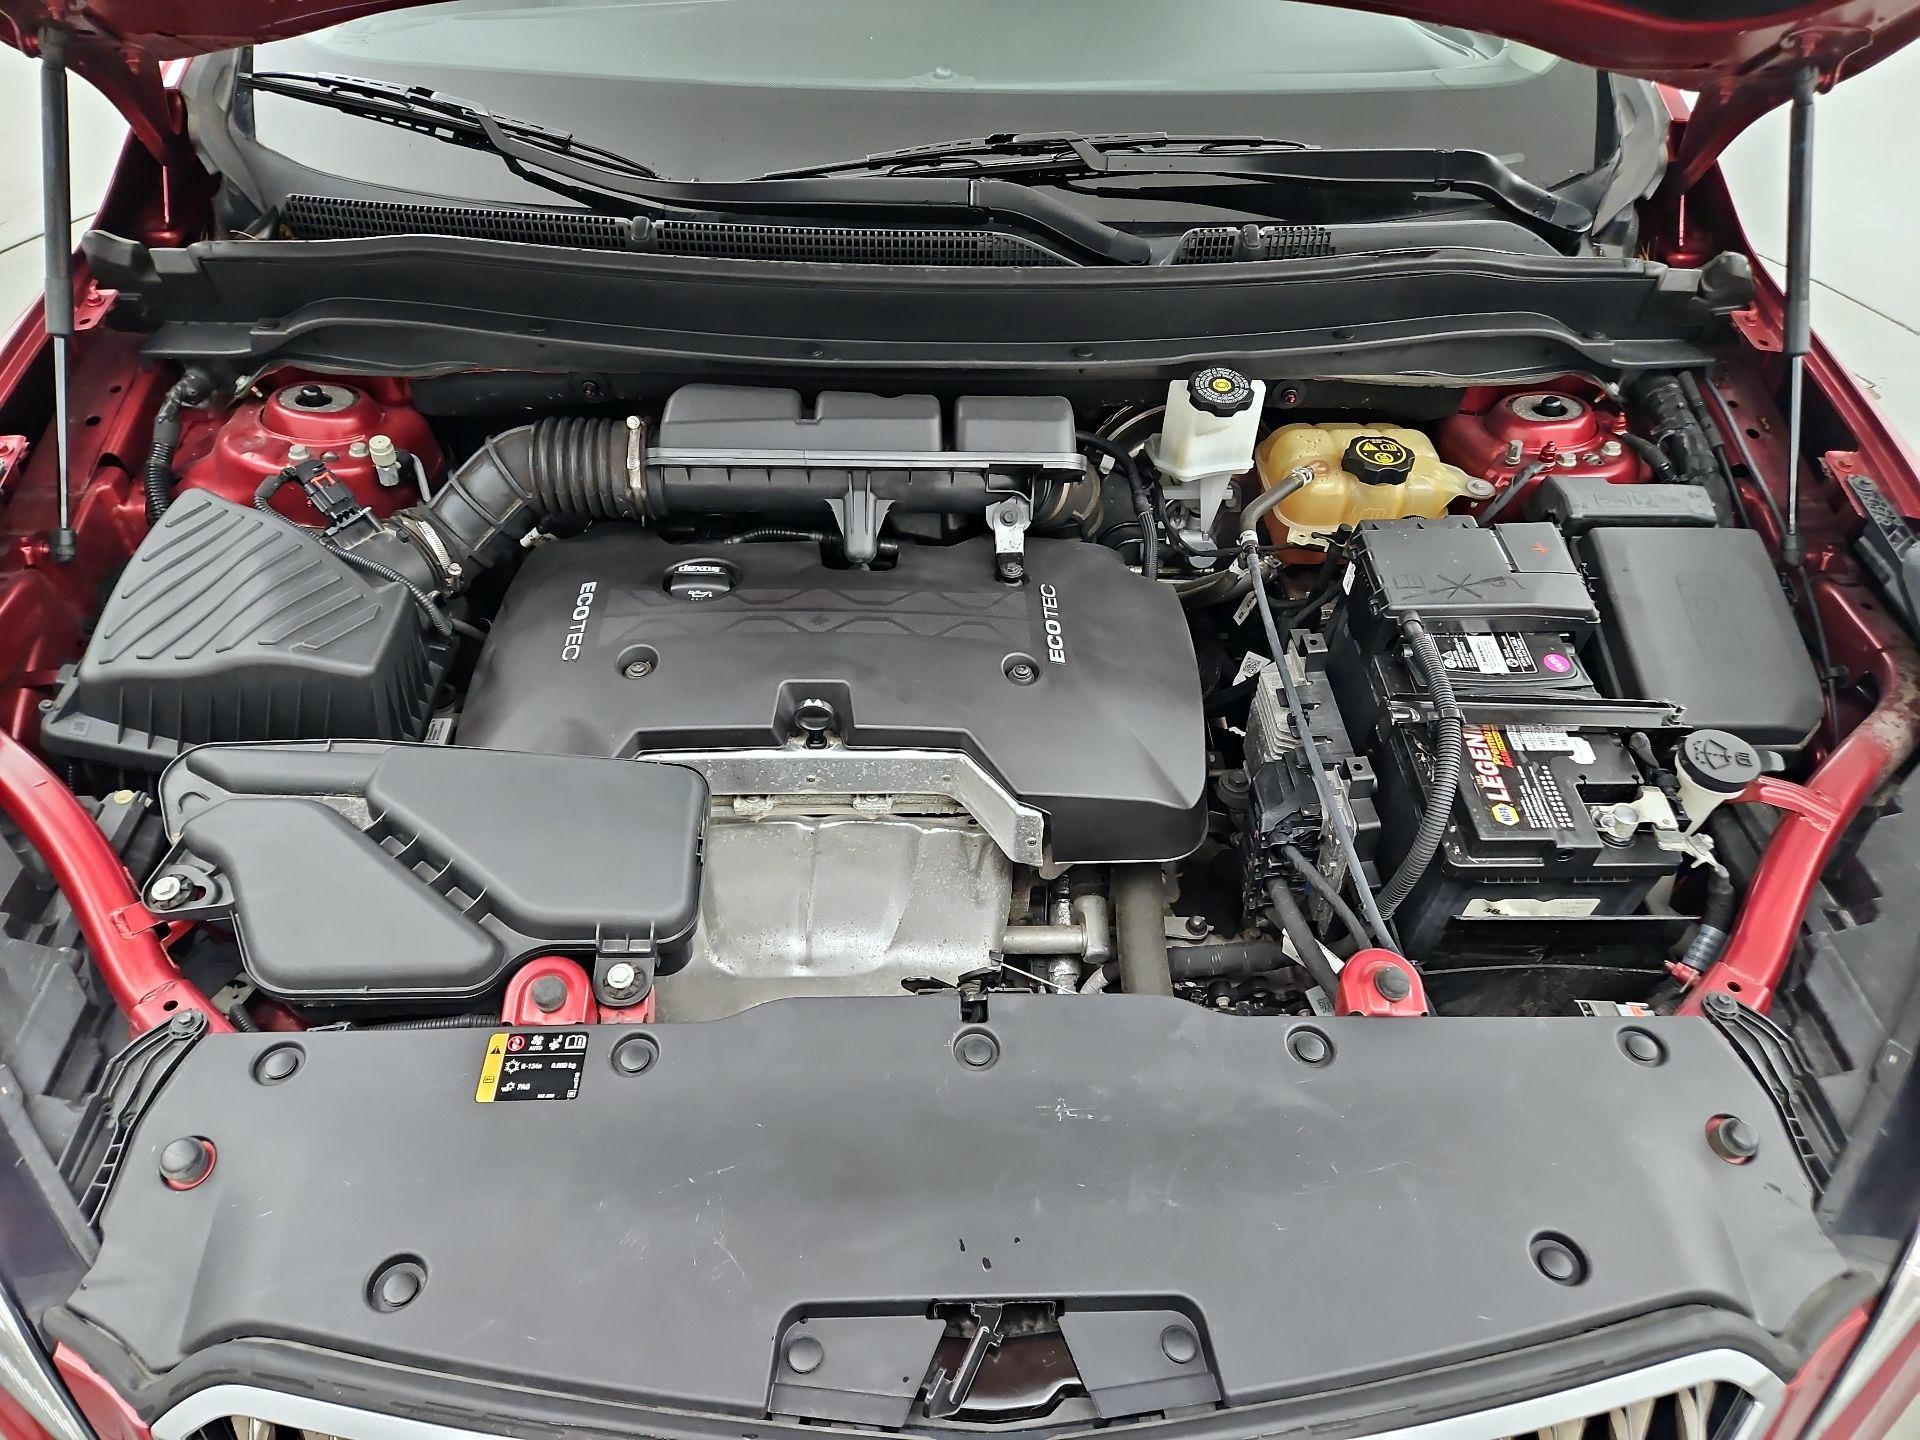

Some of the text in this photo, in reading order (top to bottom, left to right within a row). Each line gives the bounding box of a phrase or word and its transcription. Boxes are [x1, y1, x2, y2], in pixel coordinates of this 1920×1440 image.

[678, 564, 722, 573] dexos
[561, 581, 597, 662] ECOTEC
[1040, 583, 1066, 664] ECOTEC
[1462, 730, 1512, 802] LEGEN
